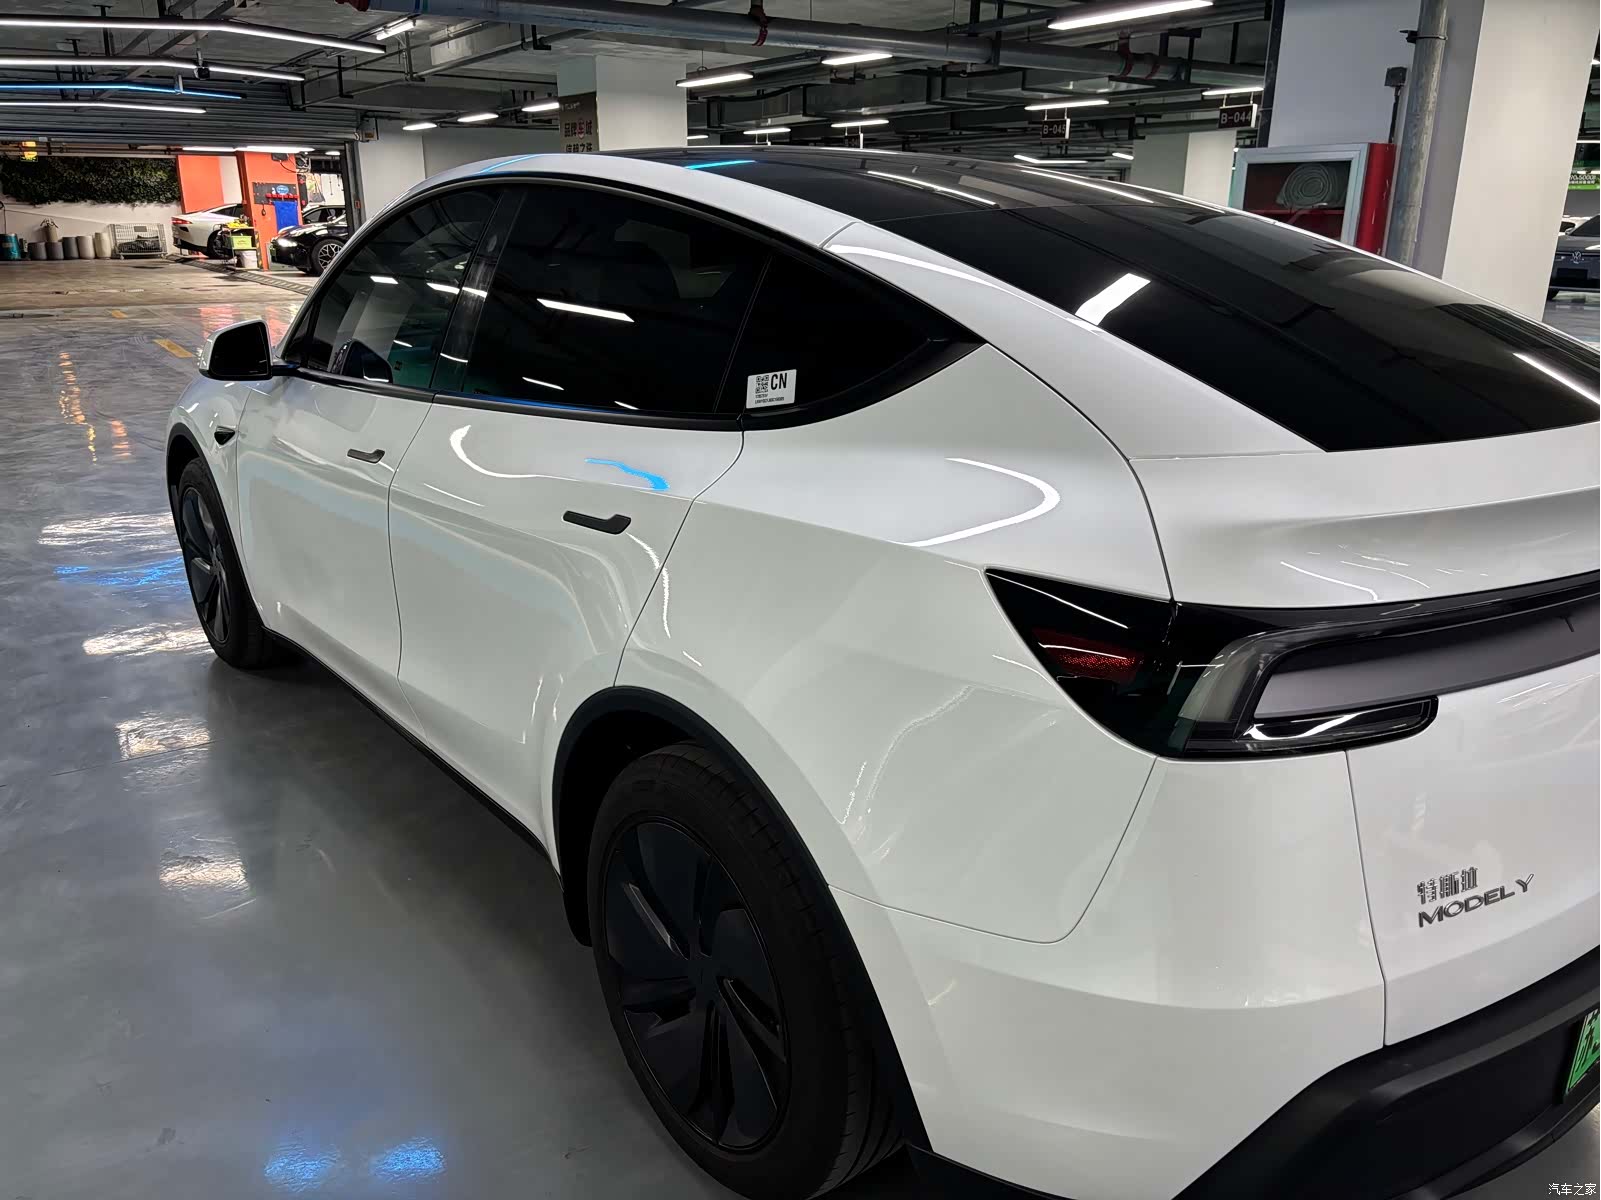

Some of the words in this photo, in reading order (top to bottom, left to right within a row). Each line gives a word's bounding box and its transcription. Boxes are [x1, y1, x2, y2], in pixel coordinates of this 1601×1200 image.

[1220, 111, 1252, 124] B-044
[771, 372, 788, 390] CN
[1416, 866, 1478, 905] 特斯拉
[1418, 885, 1516, 928] MODEL
[1515, 873, 1535, 893] Y
